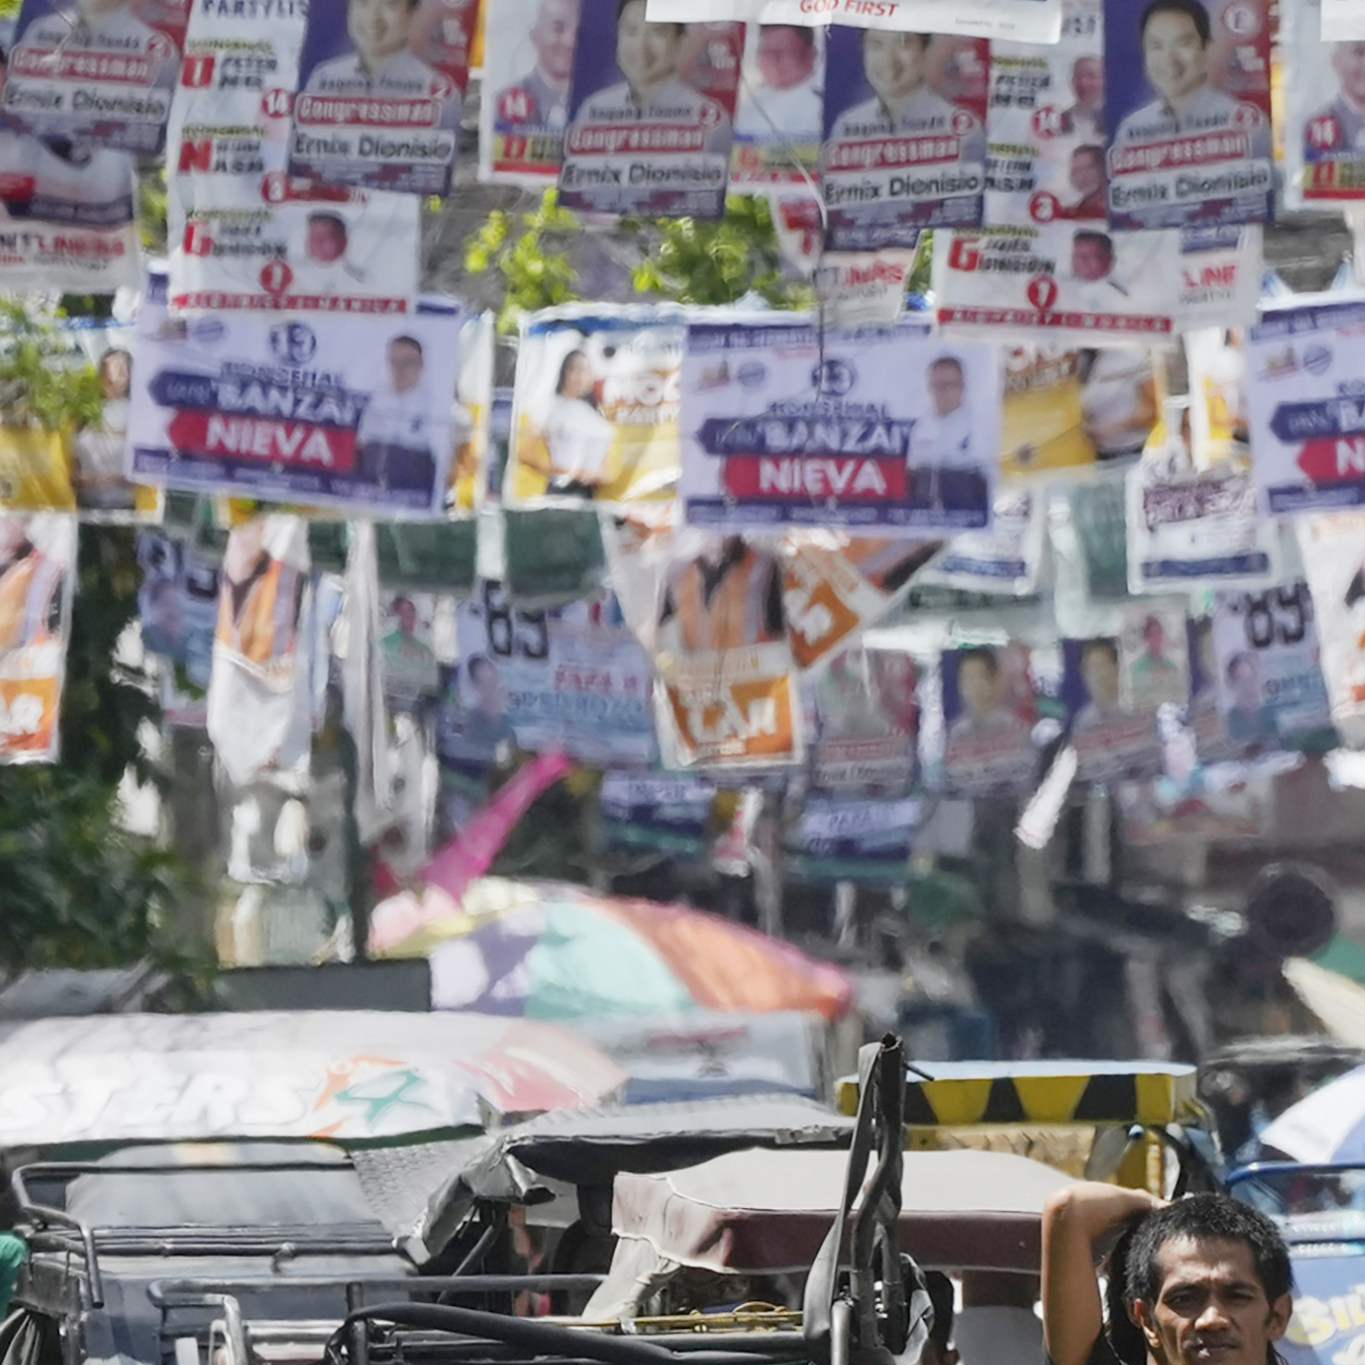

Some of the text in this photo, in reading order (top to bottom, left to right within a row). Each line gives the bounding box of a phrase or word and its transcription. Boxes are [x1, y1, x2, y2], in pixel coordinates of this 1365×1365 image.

[300, 96, 433, 122] Congressman
[570, 129, 704, 154] Congressman
[827, 138, 959, 167] Congressman
[889, 171, 979, 197] Dionisio
[204, 414, 336, 467] NIEVA
[758, 459, 888, 495] NIEVA
